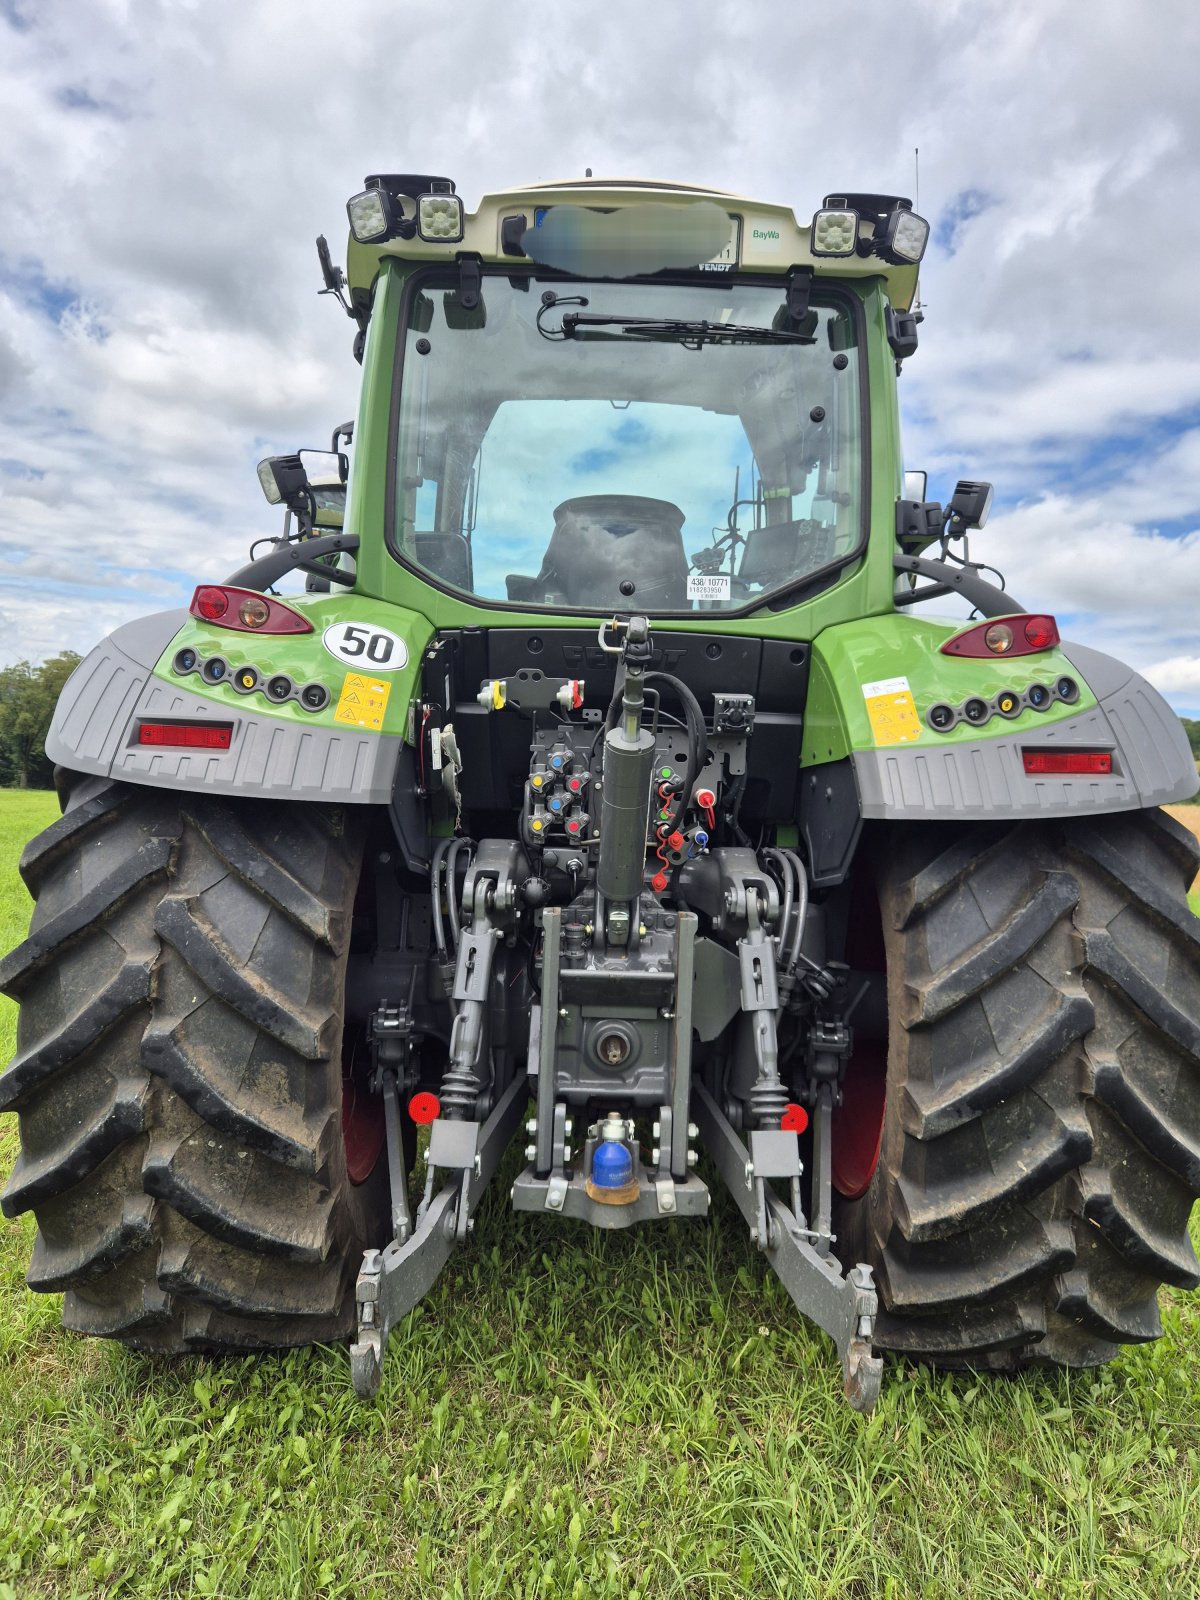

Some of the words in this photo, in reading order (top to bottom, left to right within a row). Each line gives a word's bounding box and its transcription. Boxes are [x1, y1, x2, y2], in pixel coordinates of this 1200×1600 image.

[753, 229, 780, 240] BayWa
[698, 263, 732, 272] FENDT
[339, 626, 395, 663] 50
